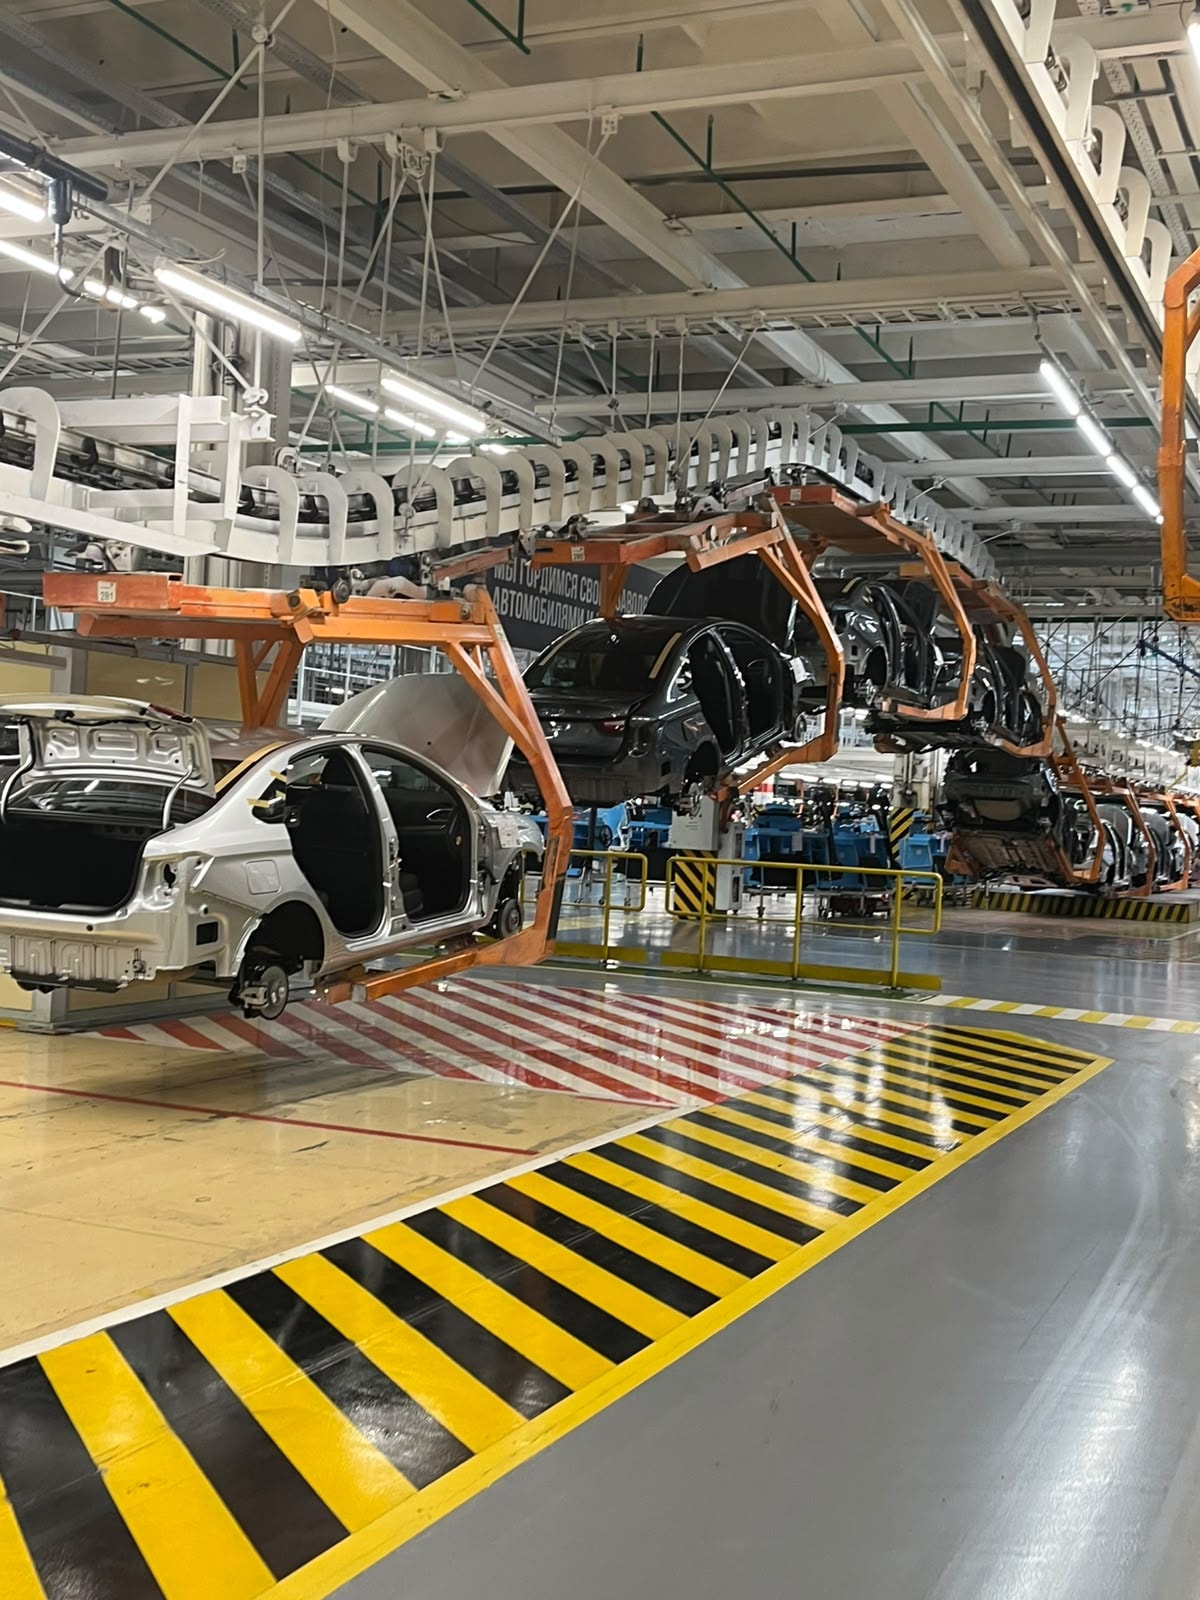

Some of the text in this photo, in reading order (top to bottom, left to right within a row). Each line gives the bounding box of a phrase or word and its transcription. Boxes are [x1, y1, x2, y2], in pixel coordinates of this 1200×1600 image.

[494, 557, 517, 583] МЫ
[519, 558, 579, 600] ГОРДИМСЯ
[580, 576, 601, 606] СВО
[493, 586, 585, 630] АВТОМОБИЛЯМИ
